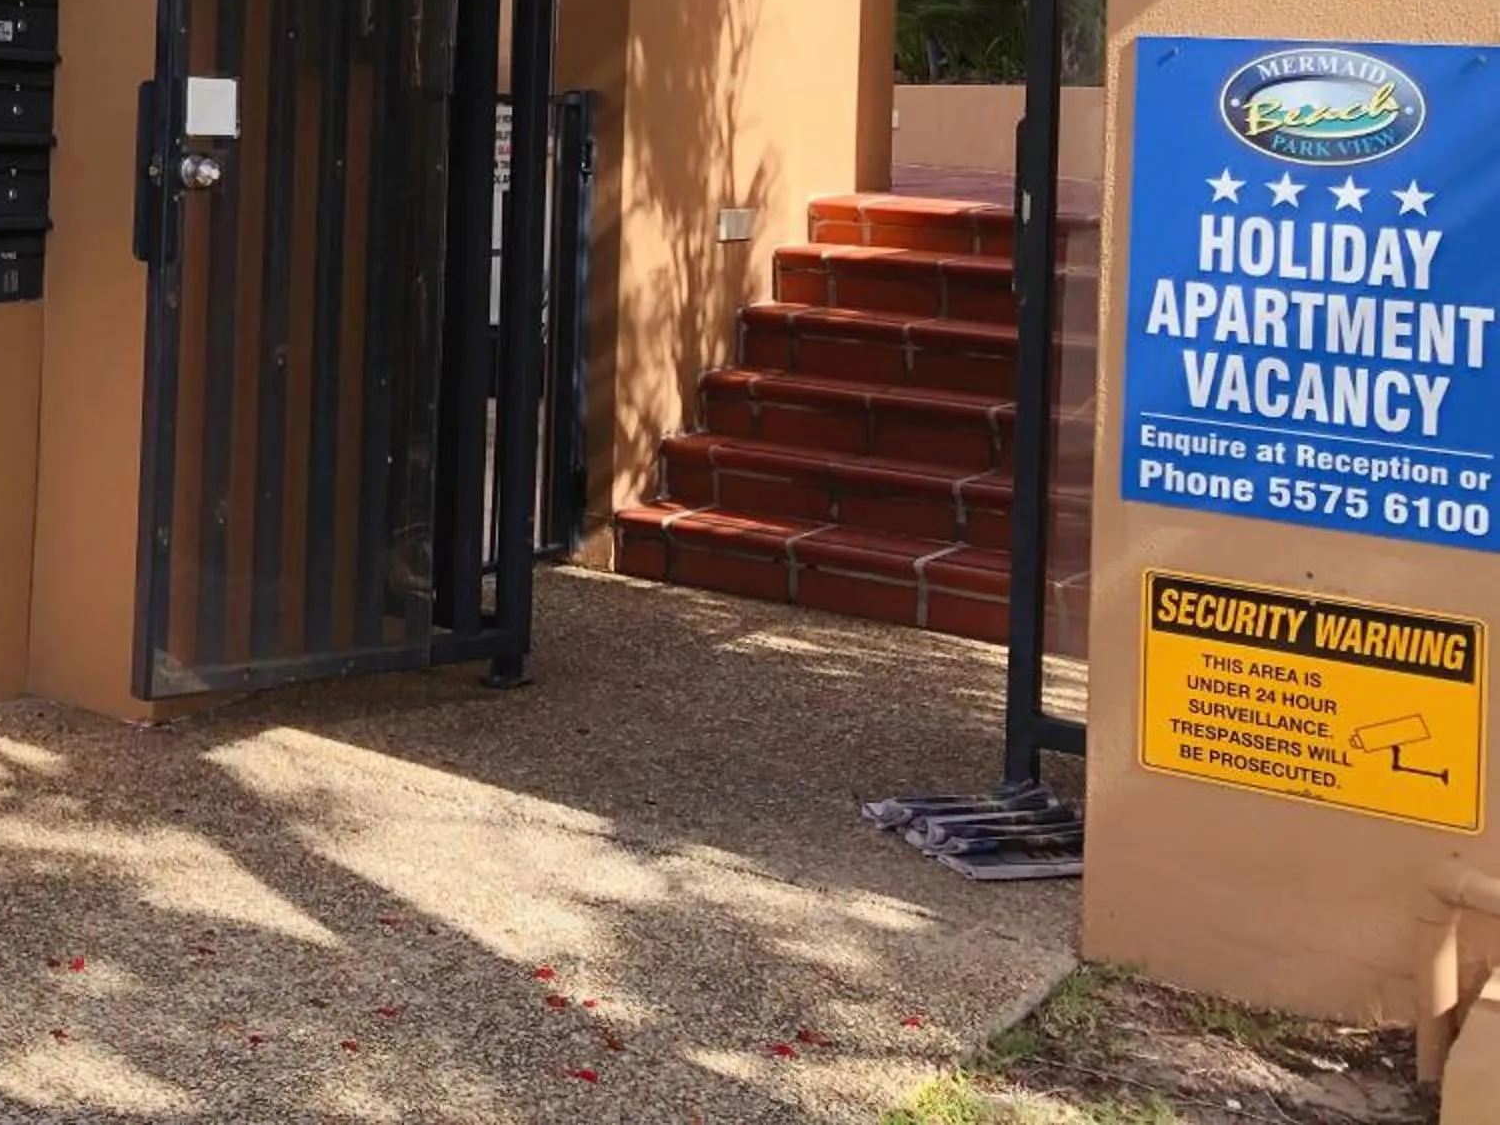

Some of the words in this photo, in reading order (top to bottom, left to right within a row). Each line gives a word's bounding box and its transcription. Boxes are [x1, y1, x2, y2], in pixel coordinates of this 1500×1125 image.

[1255, 55, 1388, 86] MERMAID
[1242, 81, 1401, 136] Beach
[1271, 134, 1332, 157] PARK
[1337, 127, 1397, 154] VIEW
[1199, 214, 1443, 291] HOLIDAY
[1146, 279, 1495, 368] APARTMENT
[1182, 349, 1450, 436] VACANCY
[1140, 425, 1247, 459] Enquire
[1256, 441, 1286, 464] at
[1296, 444, 1448, 486] Reception
[1459, 470, 1492, 492] or
[1139, 459, 1254, 503] Phone
[1268, 478, 1369, 519] 5575
[1384, 492, 1490, 536] 6100
[1157, 588, 1306, 644] SECURITY
[1314, 613, 1467, 670] WARNING
[1186, 675, 1251, 699] UNDER
[1255, 686, 1276, 704] 24
[1282, 690, 1338, 716] HOUR
[1201, 653, 1244, 674] THIS
[1248, 662, 1298, 685] AREA
[1304, 672, 1322, 688] IS
[1169, 718, 1302, 757] TRESPASSERS
[1307, 745, 1353, 768] WILL
[1188, 699, 1334, 739] SURVEILLANCE.
[1179, 744, 1203, 762] BE
[1208, 750, 1342, 790] PROSECUTED.
